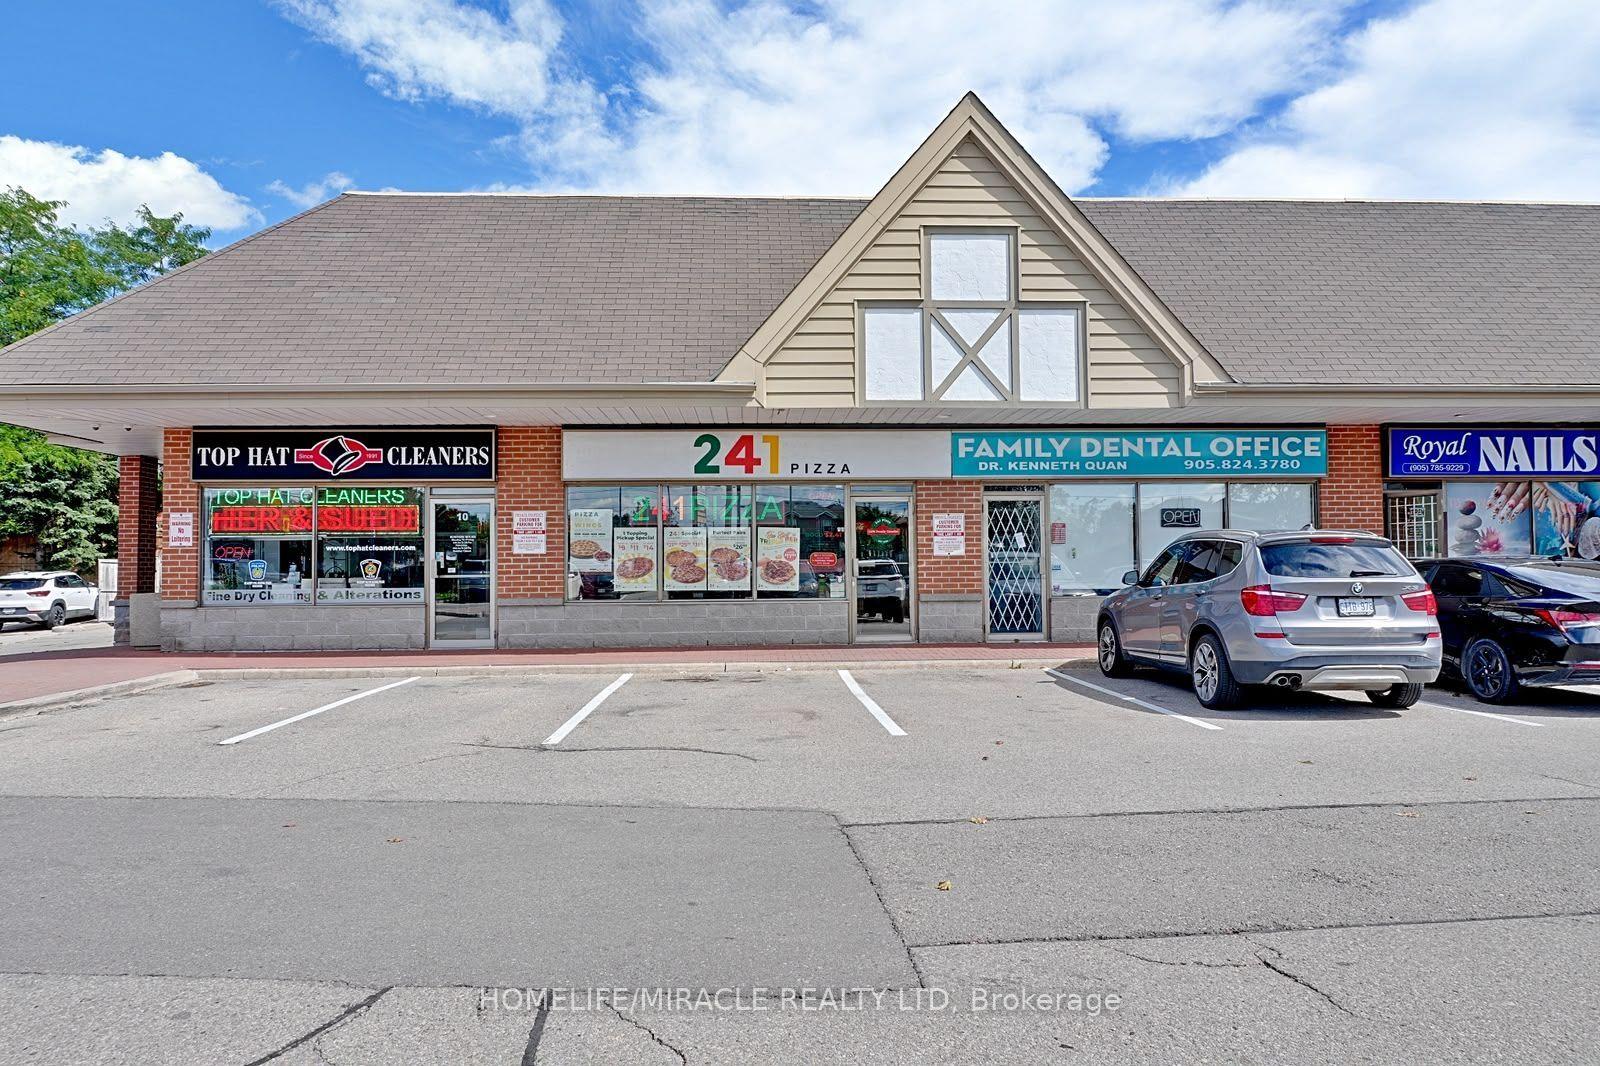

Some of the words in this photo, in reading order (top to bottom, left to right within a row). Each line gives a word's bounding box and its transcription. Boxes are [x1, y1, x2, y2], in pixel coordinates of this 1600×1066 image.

[693, 433, 780, 474] 241
[790, 463, 851, 474] PIZZA
[957, 437, 1073, 458] FAMILY
[1080, 437, 1201, 457] DENTAL
[1209, 436, 1321, 457] OFFICE
[1403, 432, 1472, 463] Royal
[197, 446, 241, 467] TOP
[247, 446, 290, 467] HAT
[386, 446, 489, 467] CLEANERS
[1477, 436, 1598, 473] NAILS
[978, 461, 1003, 471] DR.
[1008, 461, 1080, 471] KENNETH
[1085, 461, 1128, 471] QUAN
[1183, 459, 1301, 471] 905.824.3780
[1409, 464, 1429, 472] (905)
[1430, 464, 1464, 472] 785-9229
[215, 489, 252, 504] TOP
[258, 489, 292, 504] HAT
[456, 512, 469, 521] 10
[1163, 510, 1200, 523] OPEN
[214, 546, 252, 559] OPEN
[325, 544, 416, 552] www.tophatcleaners.com
[234, 591, 256, 603] Dry
[317, 590, 329, 600] &
[334, 589, 422, 600] Alterations
